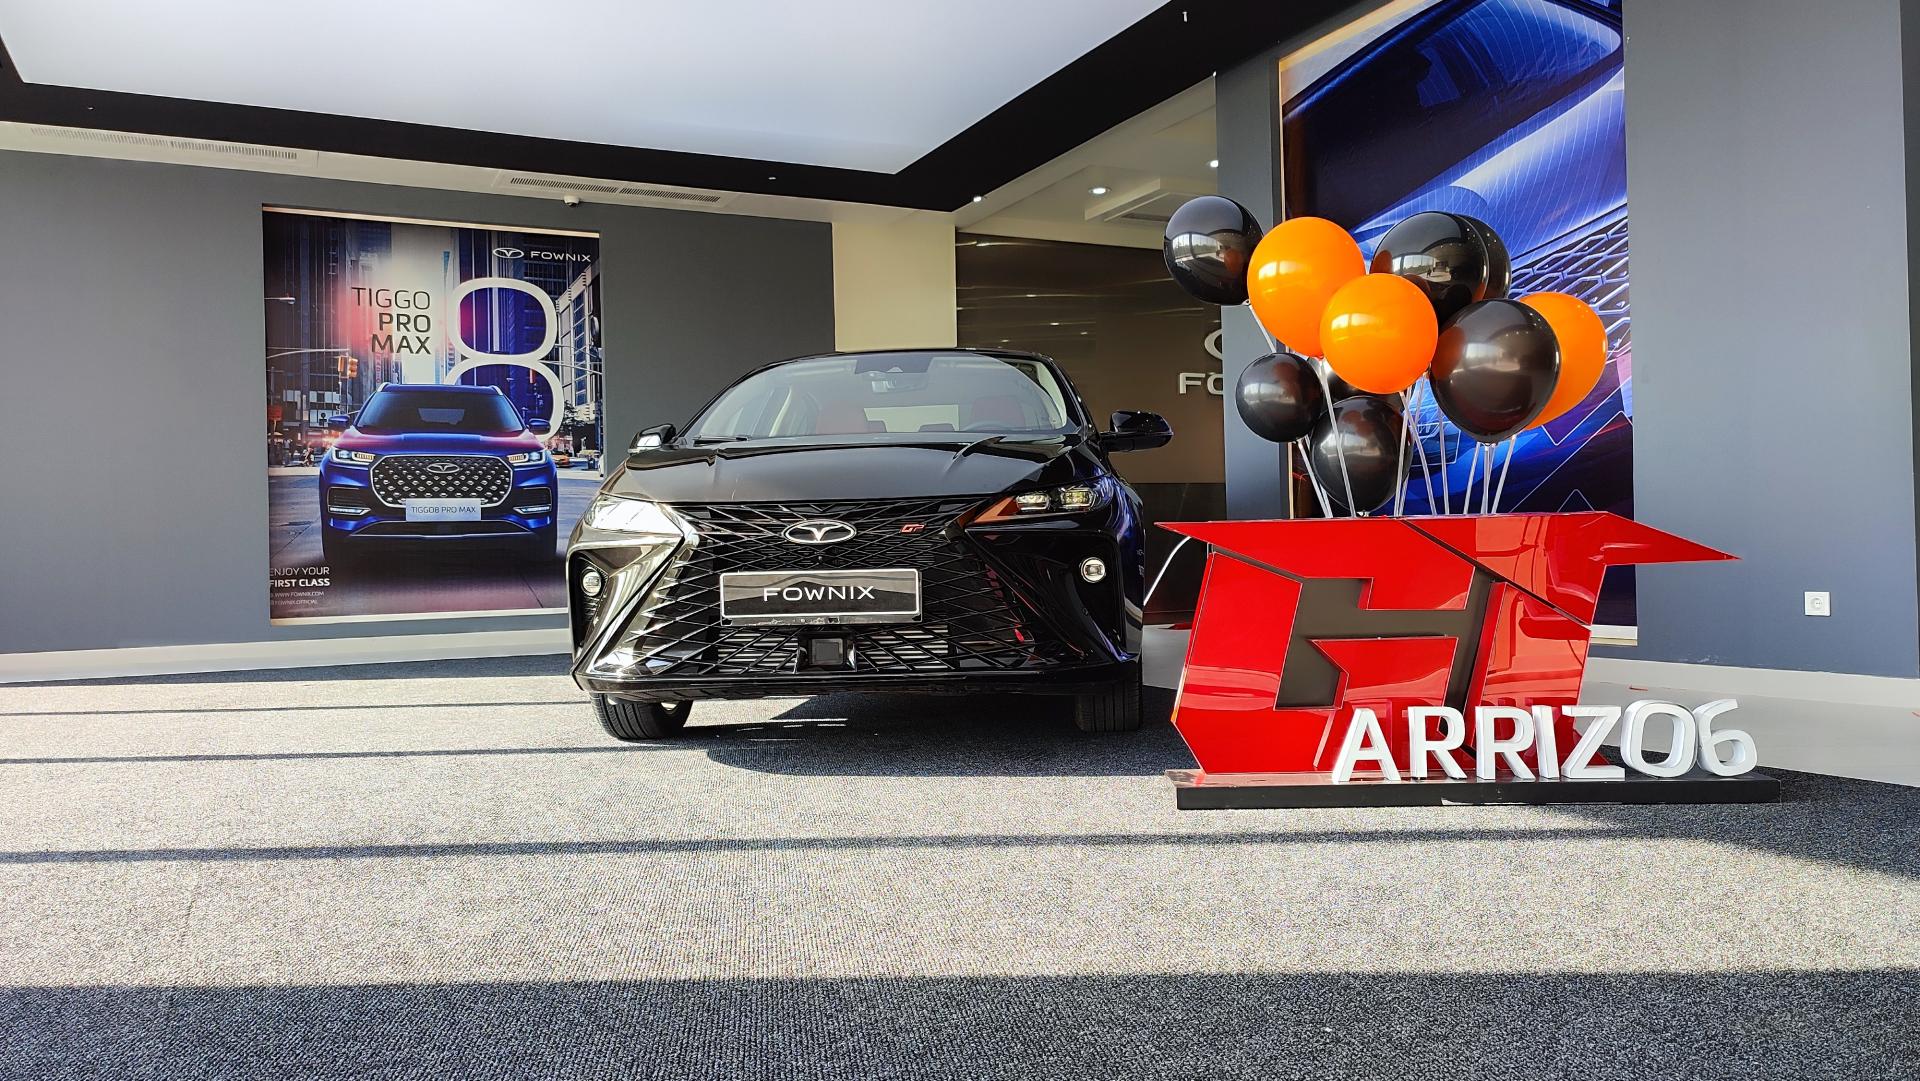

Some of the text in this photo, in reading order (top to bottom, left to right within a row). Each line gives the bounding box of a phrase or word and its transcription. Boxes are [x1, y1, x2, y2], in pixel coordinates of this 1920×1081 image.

[530, 251, 591, 262] FOWNIX
[351, 286, 431, 310] TIGGO
[379, 312, 431, 333] PRO
[371, 334, 431, 354] MAX
[444, 277, 565, 442] 8
[411, 506, 440, 514] TIGGO8
[441, 506, 457, 514] PRO
[901, 524, 925, 532] GT
[270, 566, 330, 576] ENJOY YOUR
[270, 578, 331, 588] FIRST CLASS
[763, 585, 875, 602] FOWNIX
